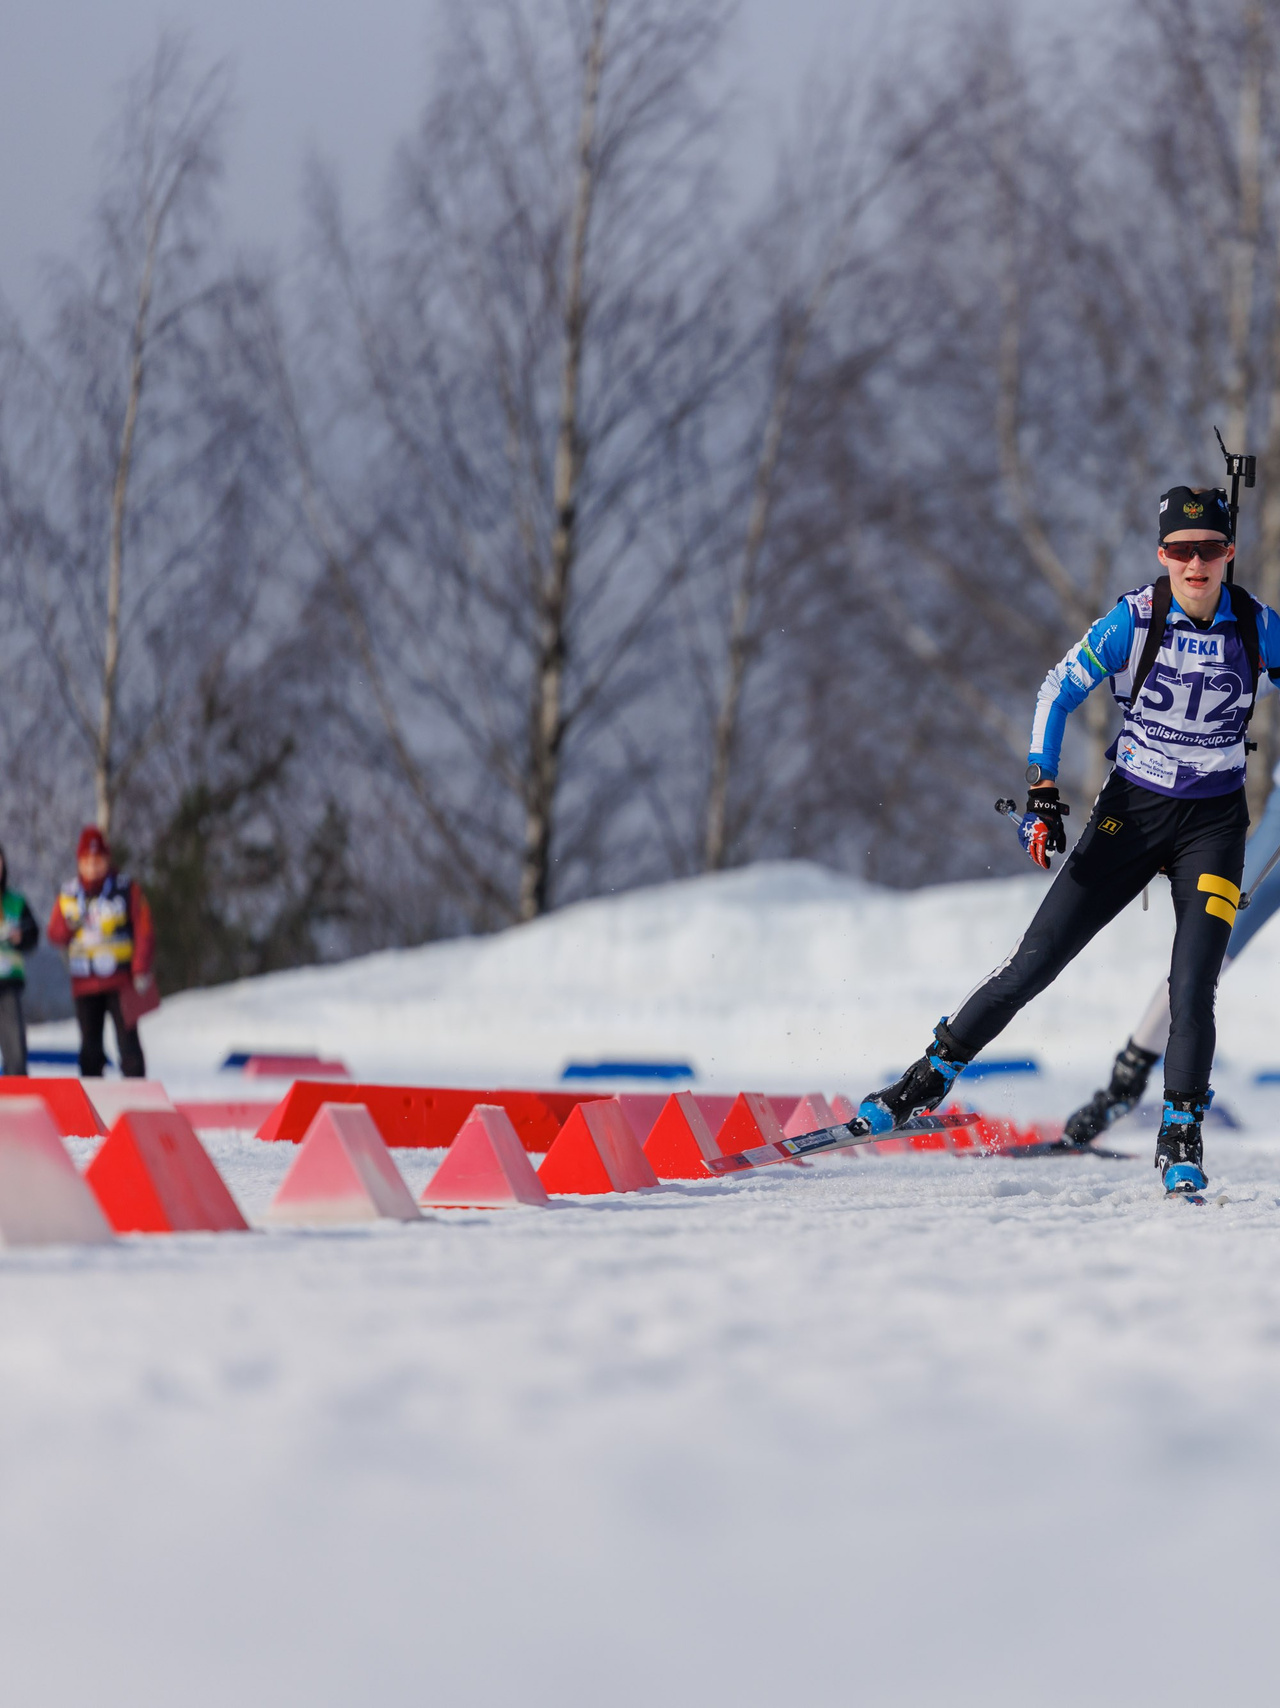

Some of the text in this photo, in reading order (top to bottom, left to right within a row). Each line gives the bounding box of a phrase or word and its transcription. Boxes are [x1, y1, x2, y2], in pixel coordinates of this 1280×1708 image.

[1095, 628, 1112, 655] CRAFT
[1177, 636, 1219, 656] VEKA
[1140, 661, 1244, 722] 512
[1033, 802, 1057, 811] MOAX
